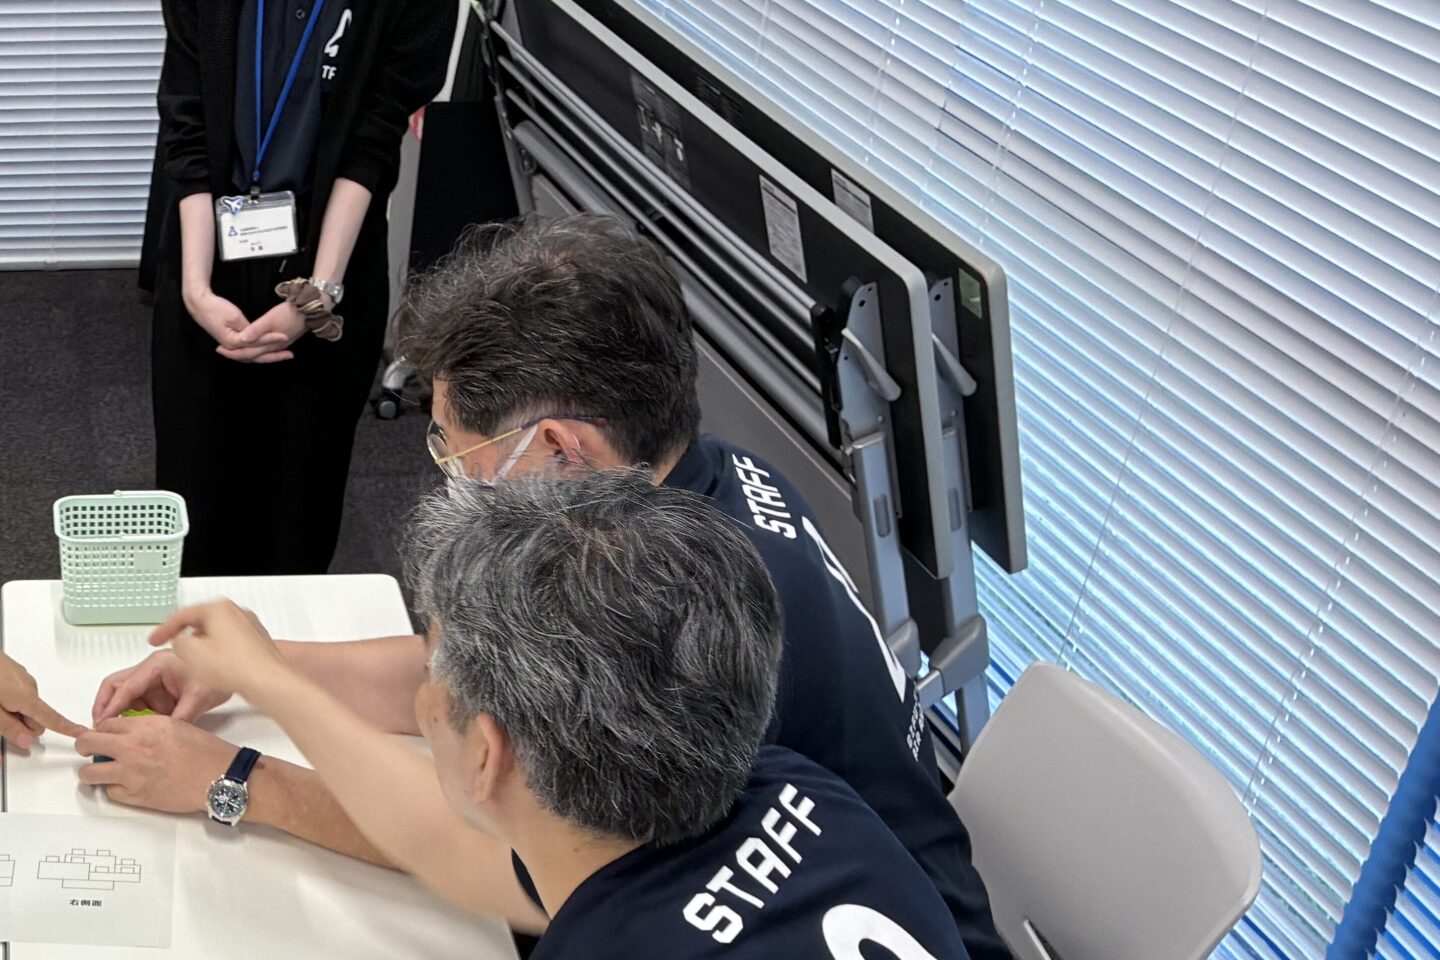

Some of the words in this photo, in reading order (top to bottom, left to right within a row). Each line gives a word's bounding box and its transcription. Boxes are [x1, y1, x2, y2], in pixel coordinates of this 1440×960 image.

[731, 453, 797, 539] STAFF
[69, 899, 102, 907] 右側面
[682, 783, 822, 944] STAFF
